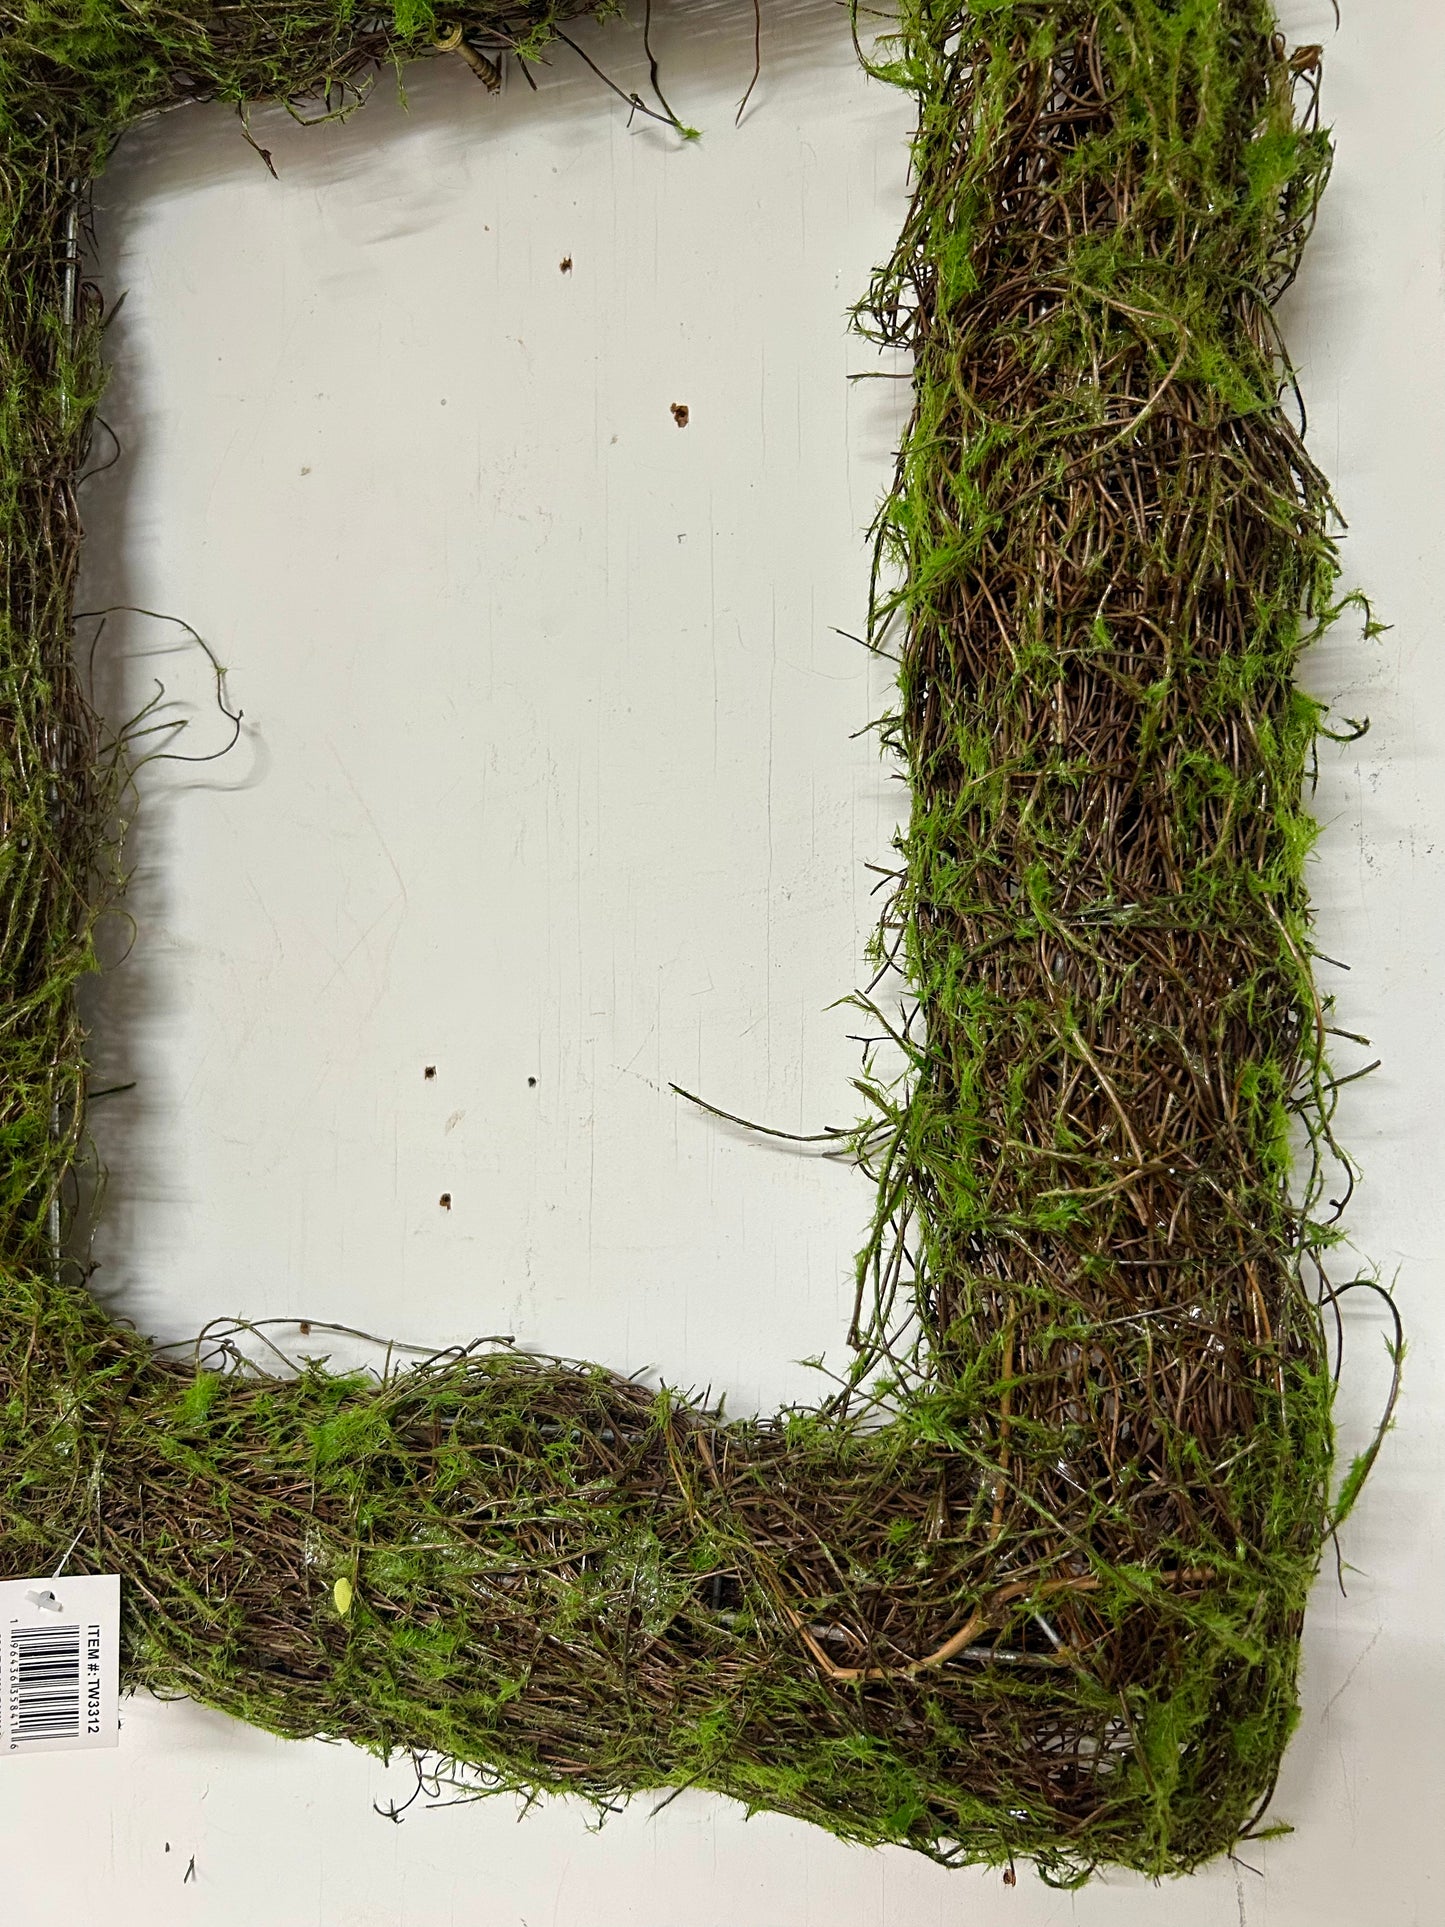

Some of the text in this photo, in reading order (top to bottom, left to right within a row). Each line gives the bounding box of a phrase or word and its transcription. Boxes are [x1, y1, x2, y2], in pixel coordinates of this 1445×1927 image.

[10, 1642, 18, 1682] 96436
[87, 1624, 100, 1660] ITEM
[10, 1688, 18, 1728] 35841
[87, 1678, 100, 1734] TW3312
